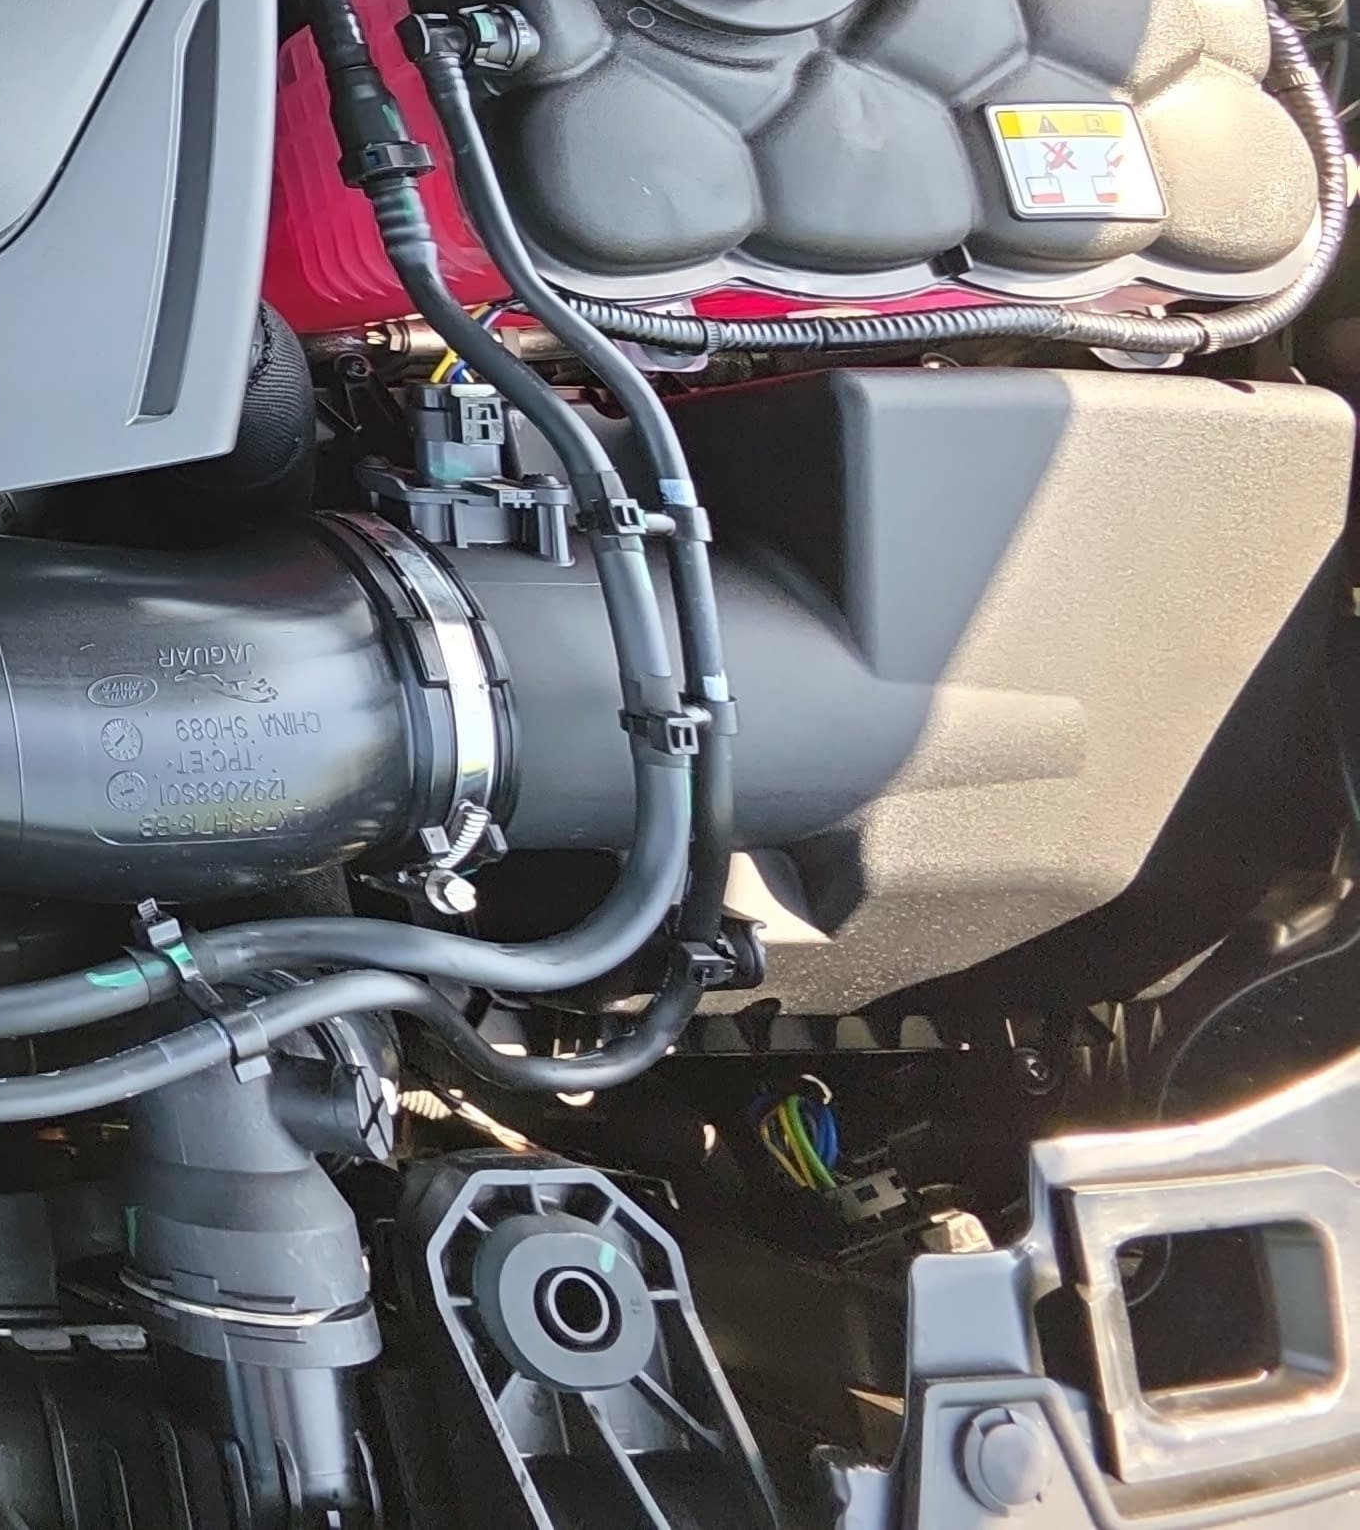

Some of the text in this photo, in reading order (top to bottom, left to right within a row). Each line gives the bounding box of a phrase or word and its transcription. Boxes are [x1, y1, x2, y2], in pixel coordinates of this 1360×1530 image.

[158, 642, 257, 668] JAGUAR
[175, 715, 249, 743] SH089
[257, 711, 322, 737] CHINA
